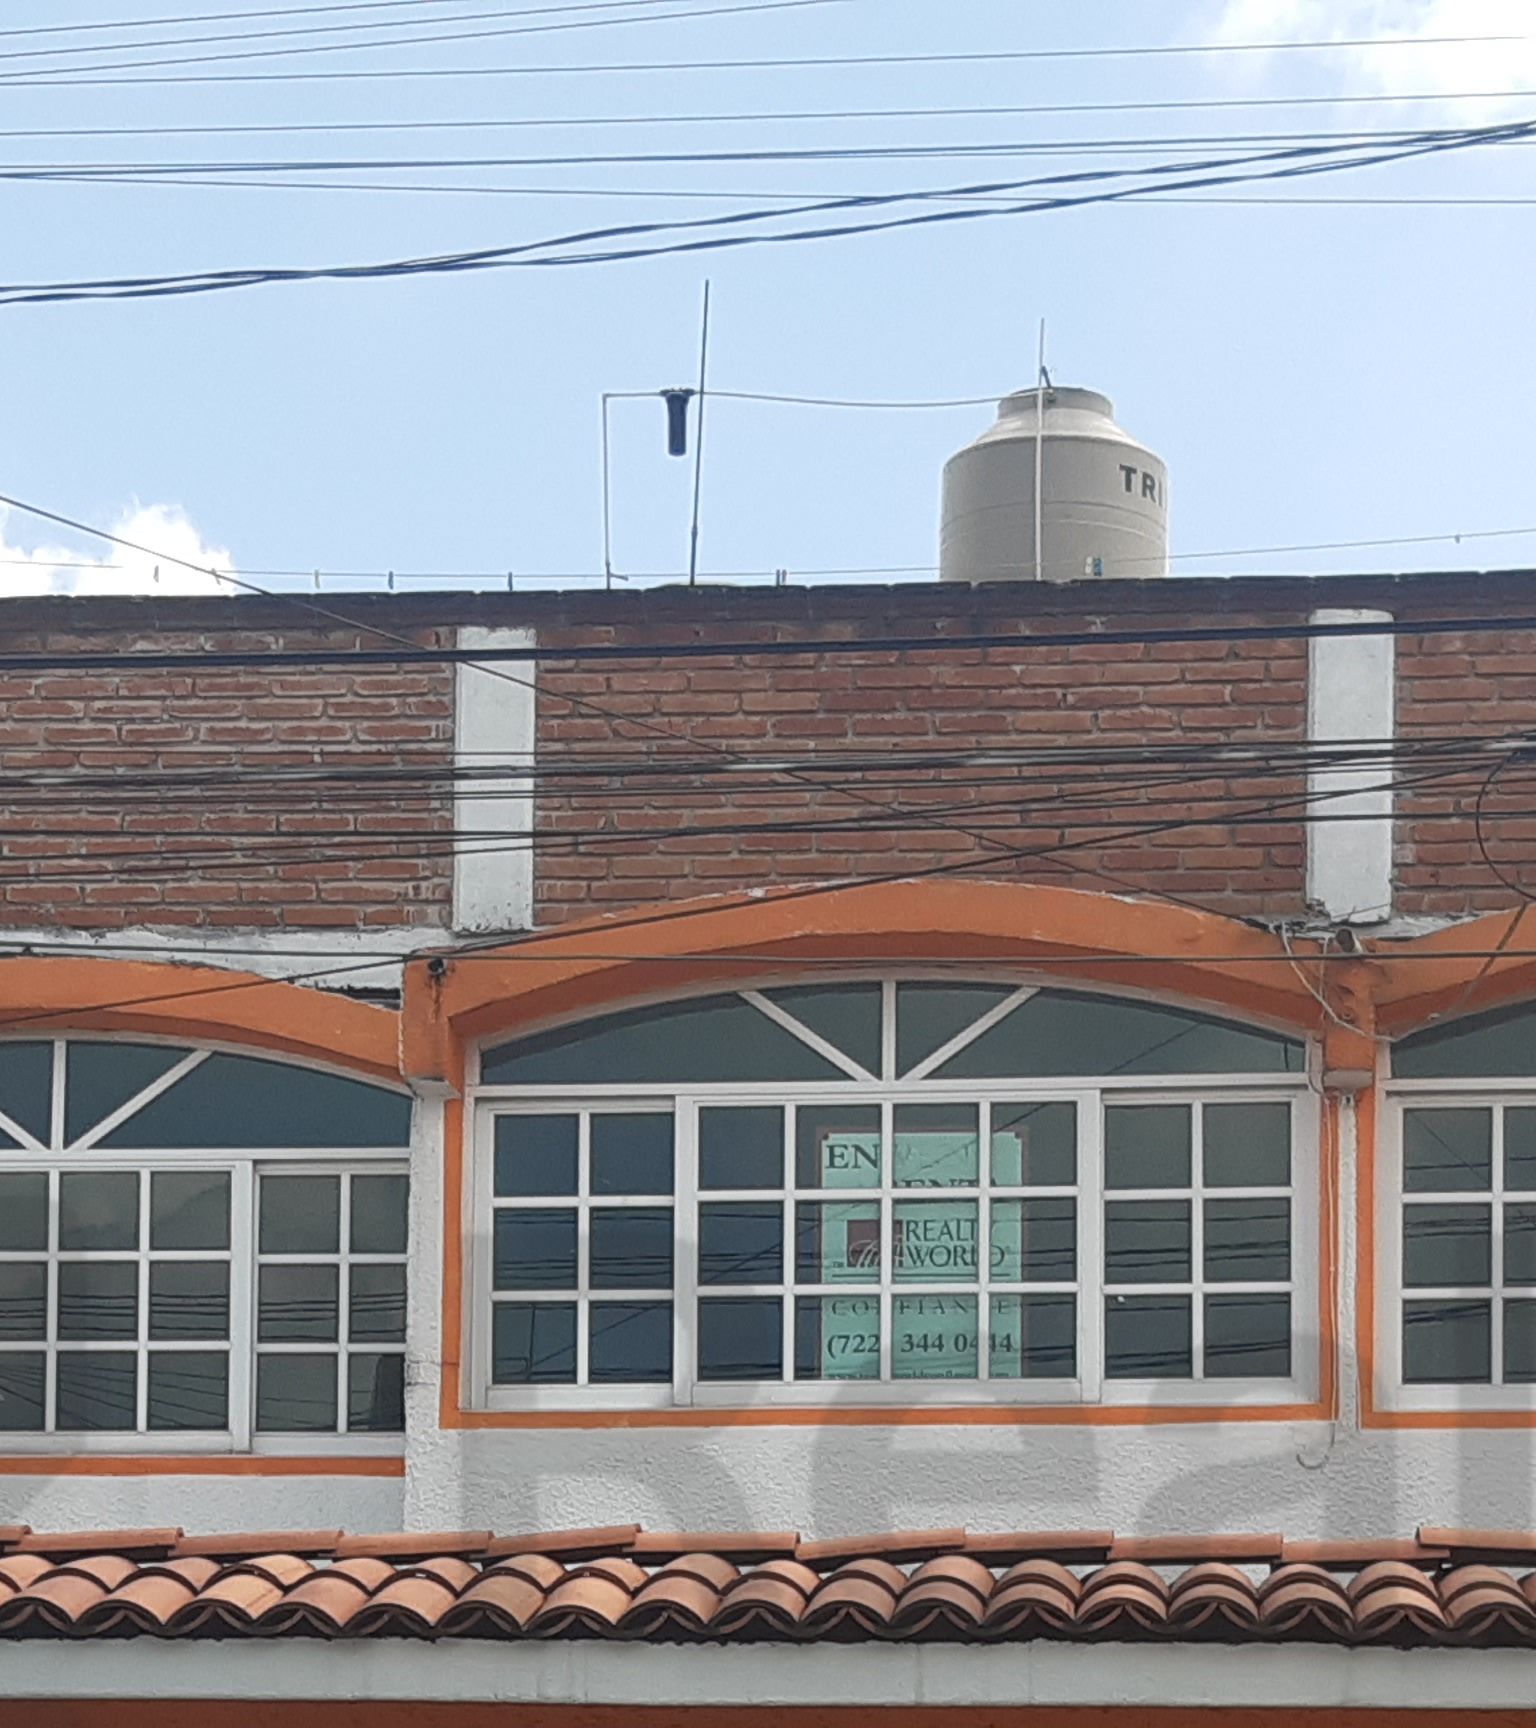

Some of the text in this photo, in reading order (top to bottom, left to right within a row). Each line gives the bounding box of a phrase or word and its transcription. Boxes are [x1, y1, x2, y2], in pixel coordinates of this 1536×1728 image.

[826, 1144, 879, 1168] EN
[906, 1219, 980, 1241] REALT
[832, 1299, 1007, 1315] COFIANE
[827, 1333, 880, 1359] (722
[901, 1333, 944, 1353] 344
